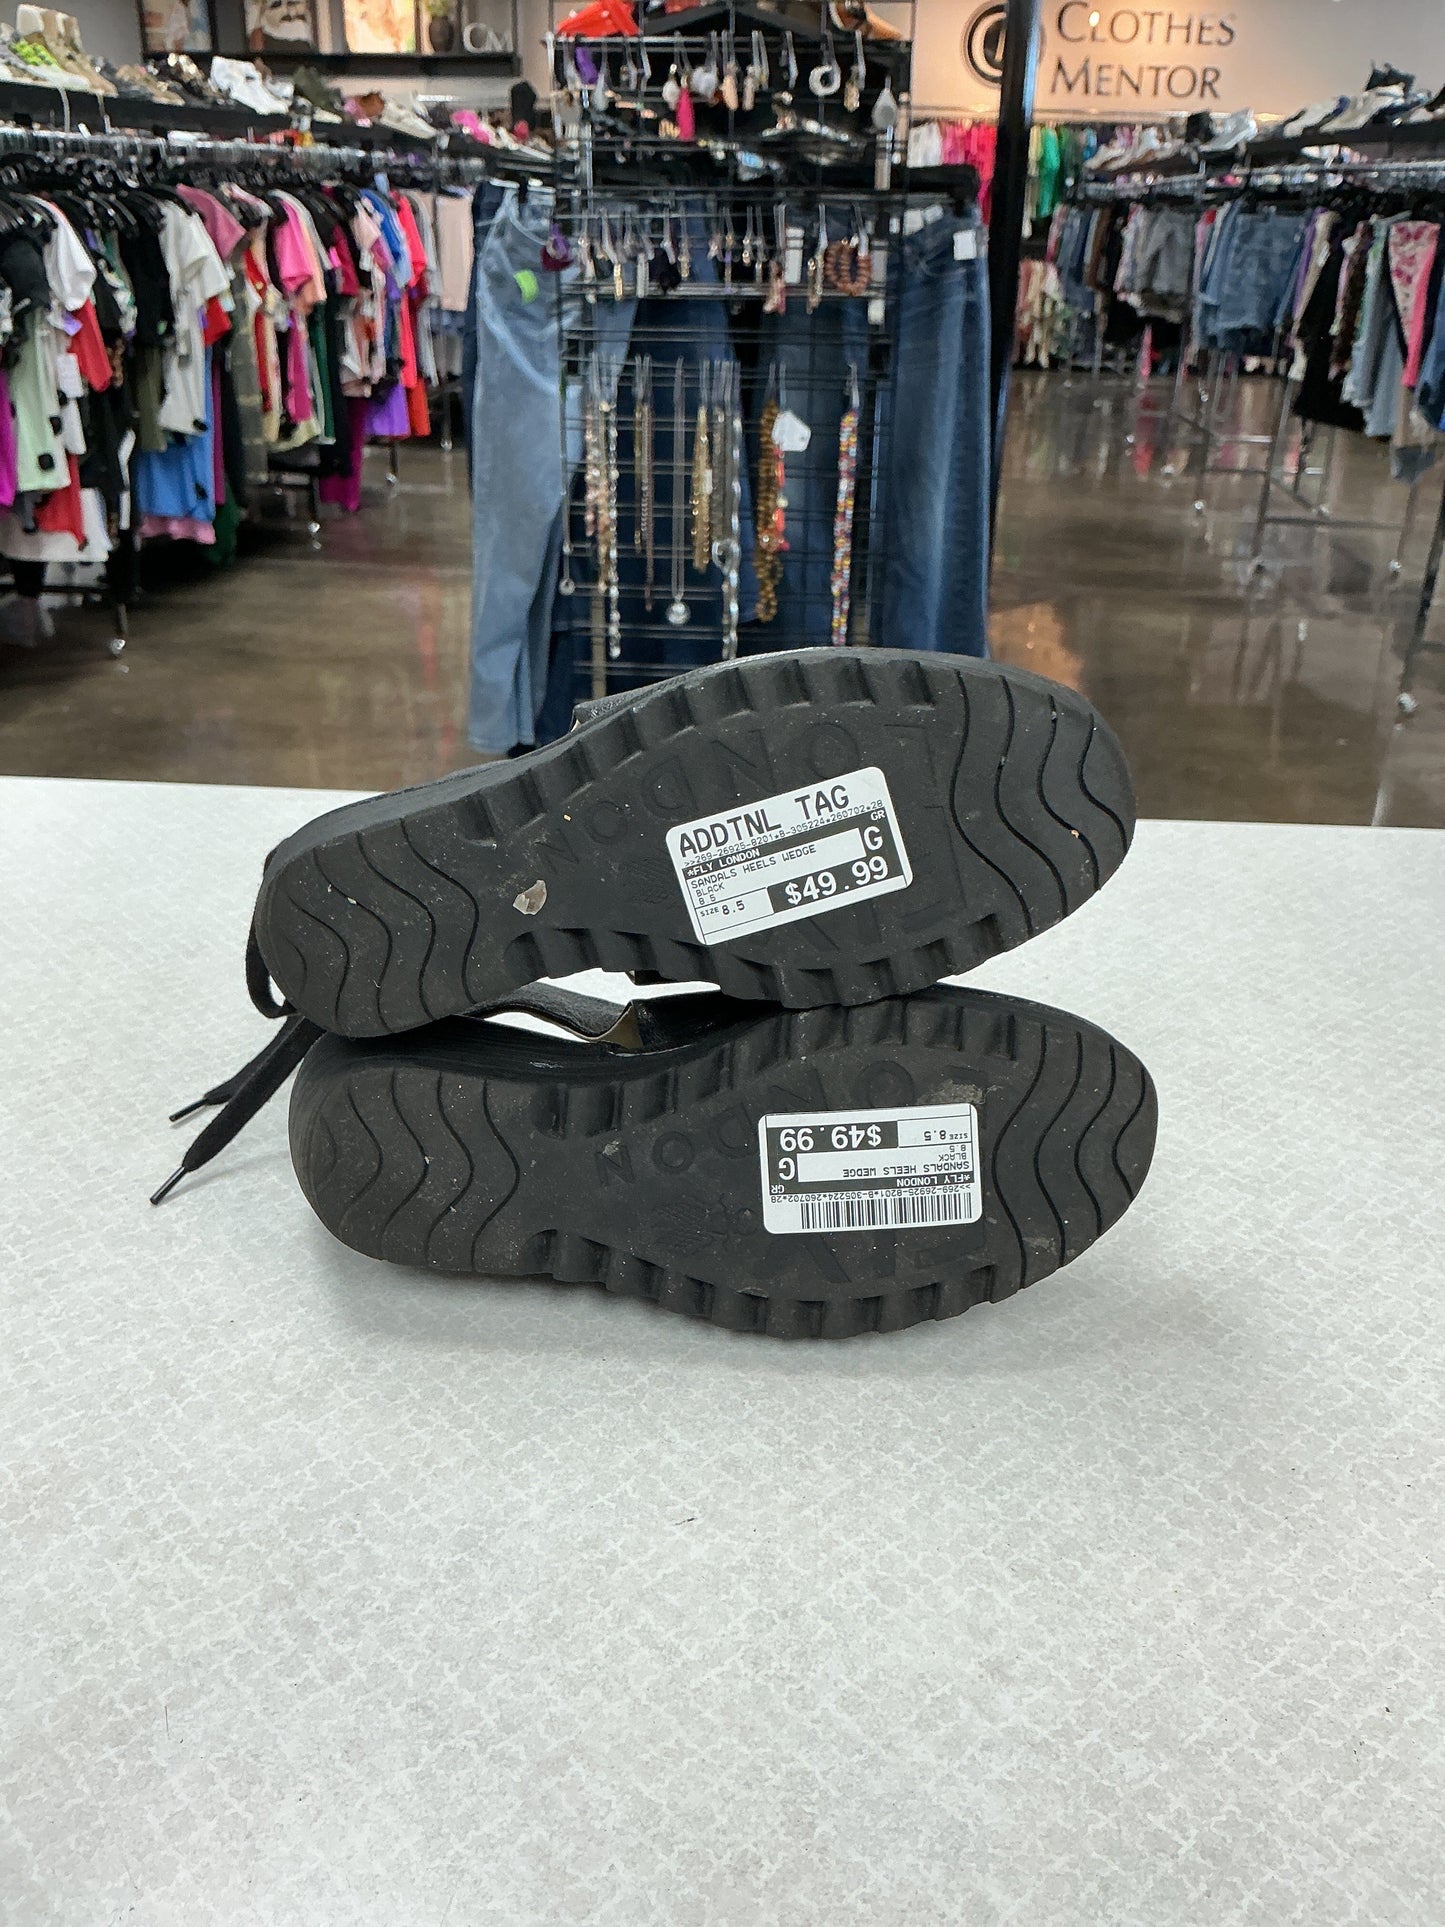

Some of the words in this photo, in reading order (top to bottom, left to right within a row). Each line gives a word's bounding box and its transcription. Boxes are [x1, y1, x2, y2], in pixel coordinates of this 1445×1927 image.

[1057, 1, 1234, 46] CLOTHES
[463, 22, 514, 53] CM
[1051, 56, 1221, 99] MENTOR
[679, 808, 782, 858] ADDTNL
[794, 784, 850, 820] TAG
[870, 809, 886, 821] GR
[863, 826, 884, 850] G
[719, 848, 761, 868] LONDON
[690, 869, 737, 889] SANDALS
[743, 857, 777, 874] HEELS
[782, 844, 817, 861] WEDGE
[785, 855, 888, 905] $49.99
[696, 883, 725, 898] BLACK
[698, 894, 717, 906] 8.5
[700, 906, 720, 917] SIZE
[721, 900, 745, 916] 8.5
[780, 1123, 882, 1152] $49.99
[924, 1129, 947, 1141] 8.5
[949, 1132, 968, 1140] SIZE
[949, 1144, 967, 1153] 8.5
[938, 1152, 967, 1162] BLACK
[778, 1157, 796, 1180] G
[842, 1167, 877, 1178] WEDGE
[883, 1165, 917, 1175] HEELS
[923, 1161, 970, 1172] SANDALS
[896, 1175, 938, 1187] LONDON
[771, 1184, 785, 1194] GR
